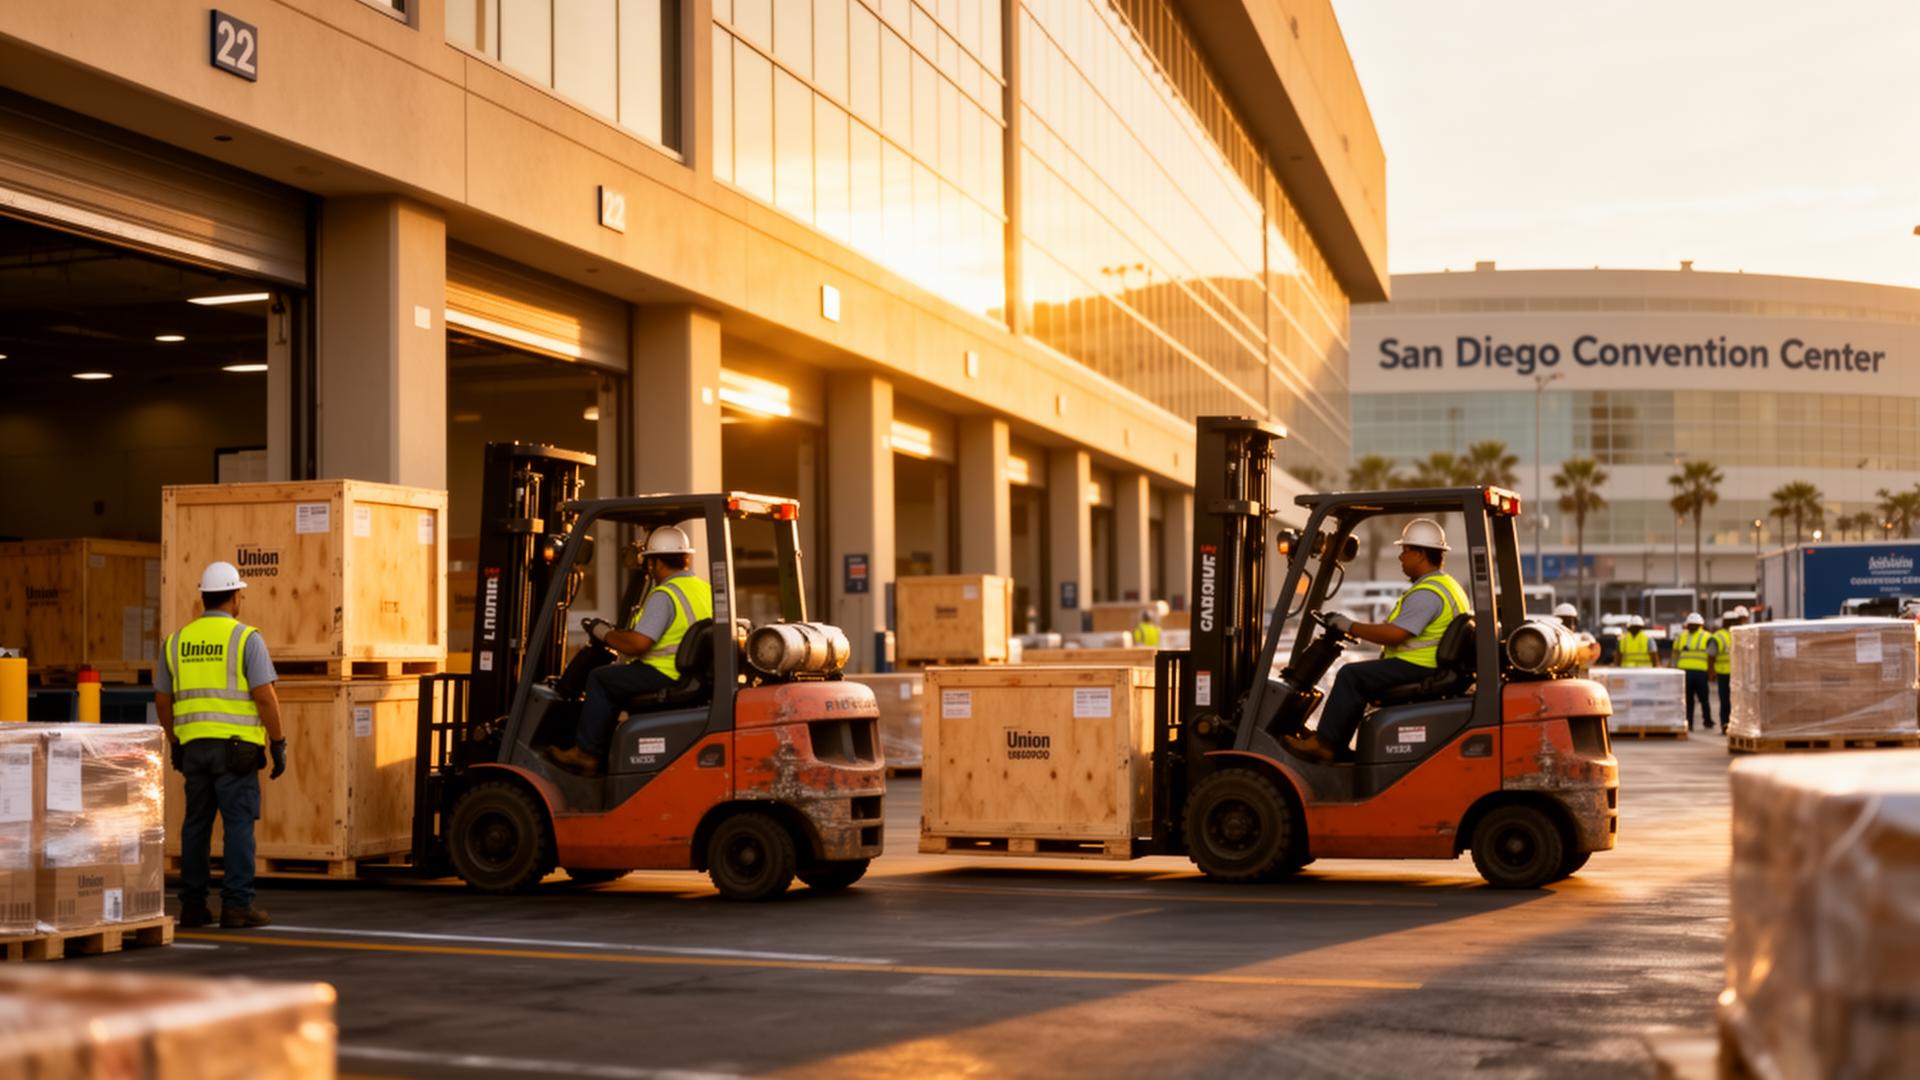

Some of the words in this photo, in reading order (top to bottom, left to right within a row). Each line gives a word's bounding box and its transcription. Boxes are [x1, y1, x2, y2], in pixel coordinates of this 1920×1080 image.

[217, 20, 255, 74] 22
[1379, 337, 1443, 370] San
[1456, 335, 1561, 376] Diego
[1572, 335, 1769, 368] Convention
[1780, 338, 1885, 373] Center
[237, 548, 279, 566] Union
[181, 640, 223, 657] Union
[1007, 730, 1051, 749] Union
